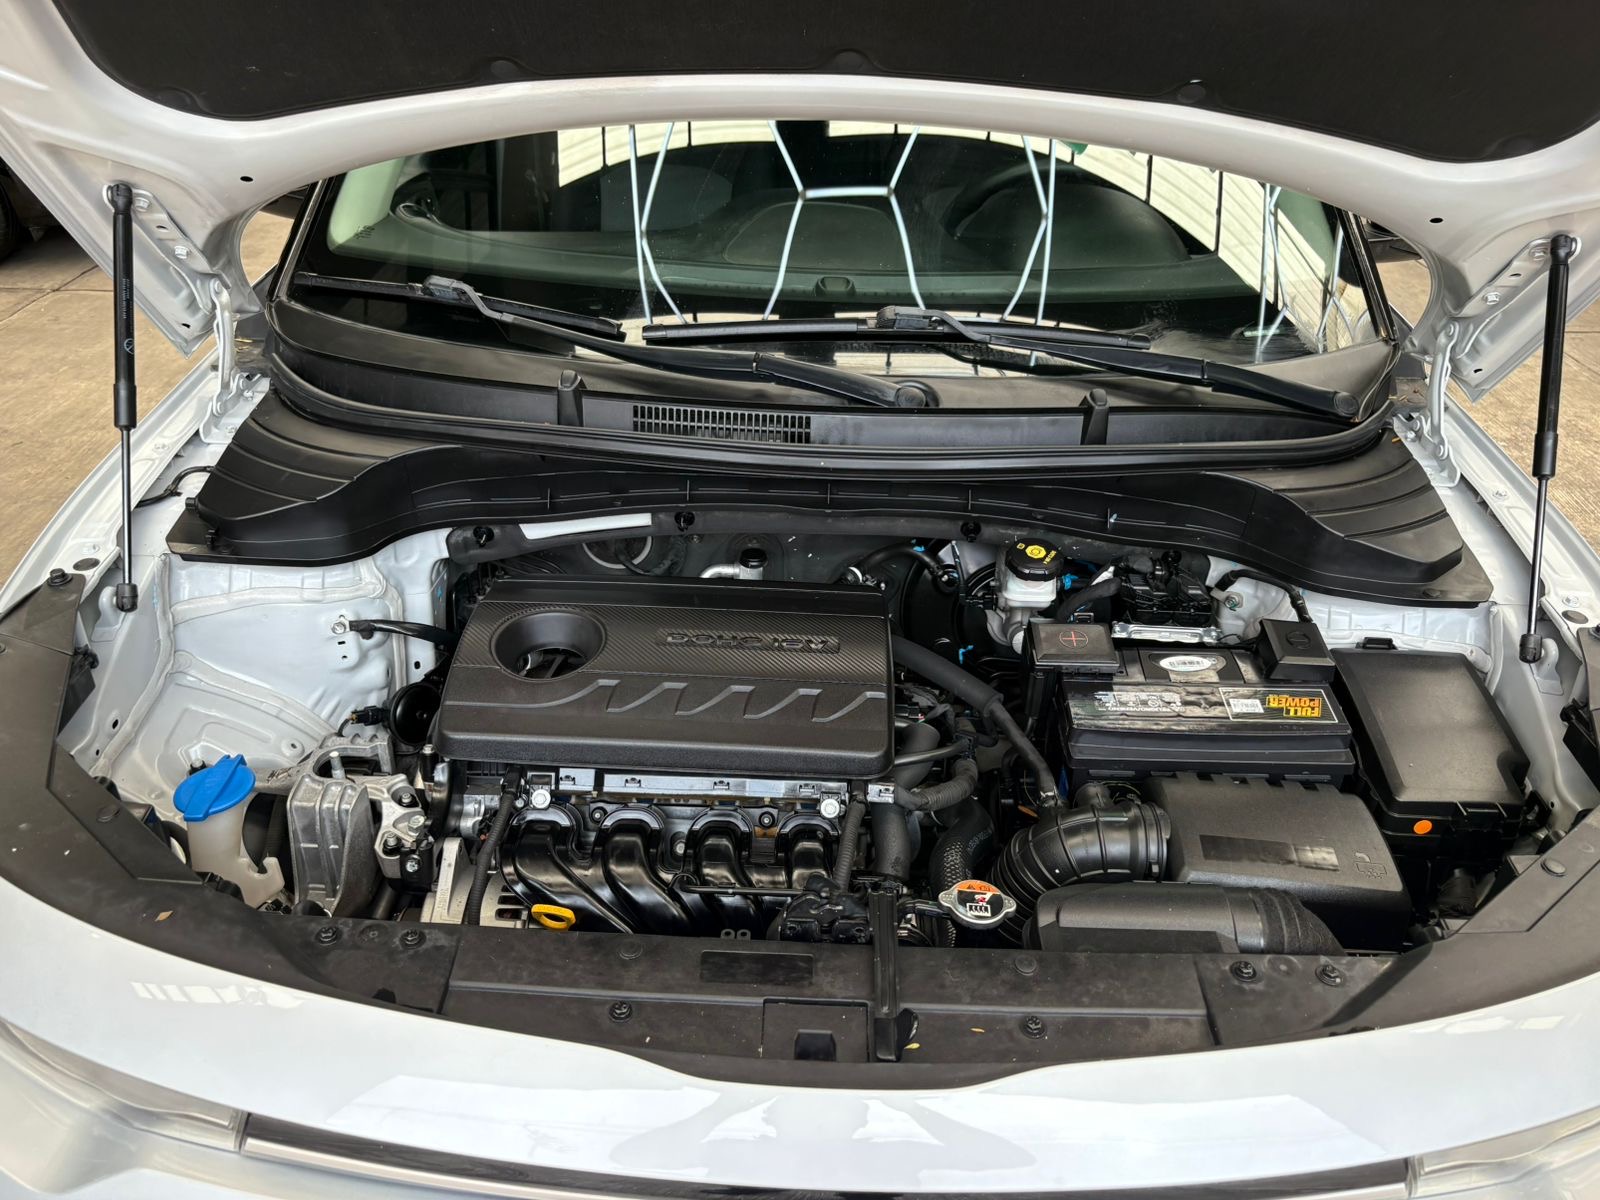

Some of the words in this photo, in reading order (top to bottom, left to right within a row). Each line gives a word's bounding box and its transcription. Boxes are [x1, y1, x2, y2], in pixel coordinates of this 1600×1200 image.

[667, 633, 763, 647] DOHC
[1268, 696, 1320, 708] POWER
[1287, 706, 1320, 717] FULL
